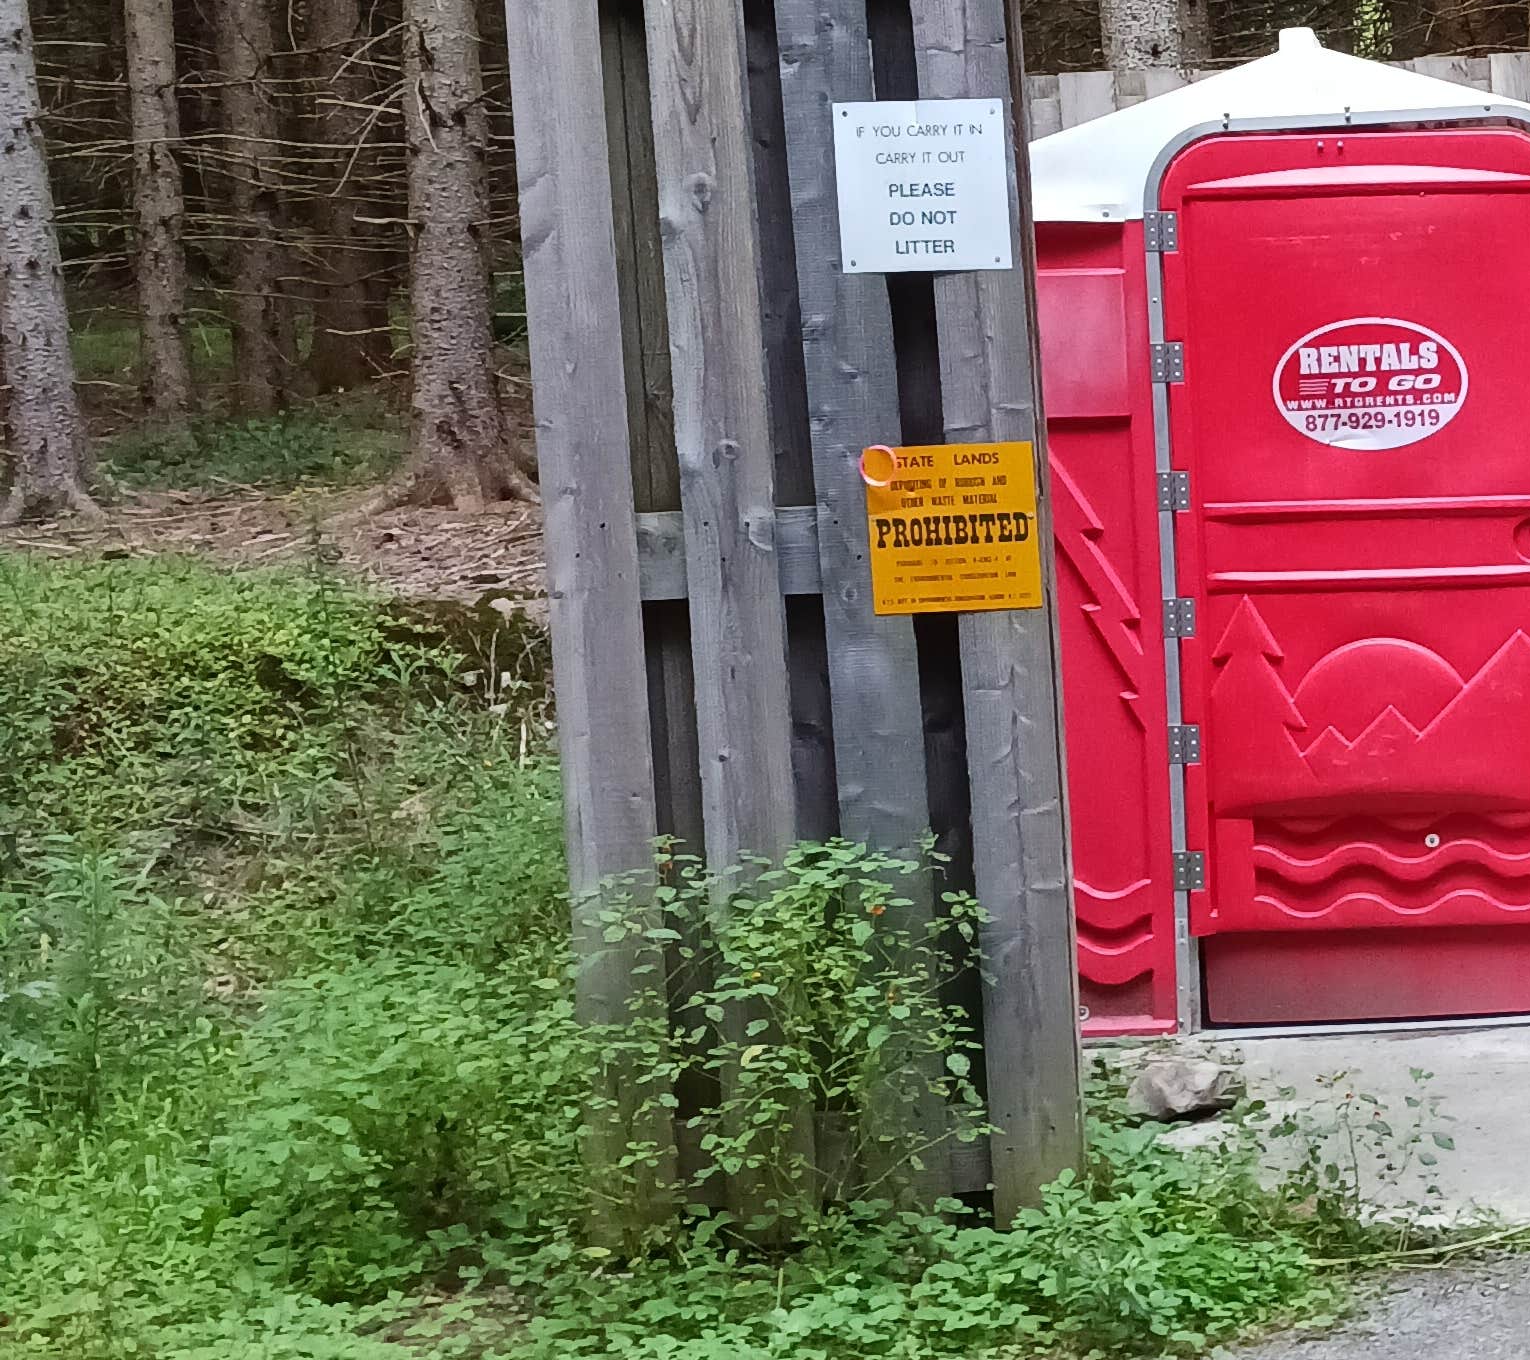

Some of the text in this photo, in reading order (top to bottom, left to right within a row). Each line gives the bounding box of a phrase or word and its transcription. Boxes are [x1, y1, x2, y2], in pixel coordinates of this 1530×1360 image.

[856, 123, 983, 138] IF YOU CARRY IT IN
[875, 150, 966, 165] CARRY IT OUT
[888, 182, 955, 198] PLEASE
[889, 210, 957, 226] DO NOT
[895, 240, 955, 255] LITTER
[1299, 341, 1439, 375] RENTALS
[1330, 373, 1442, 394] TO GO
[1305, 409, 1440, 432] 877-929-1919
[953, 452, 999, 466] LANDS
[931, 495, 956, 506] WASTE
[875, 511, 1029, 549] PROHIBITED
